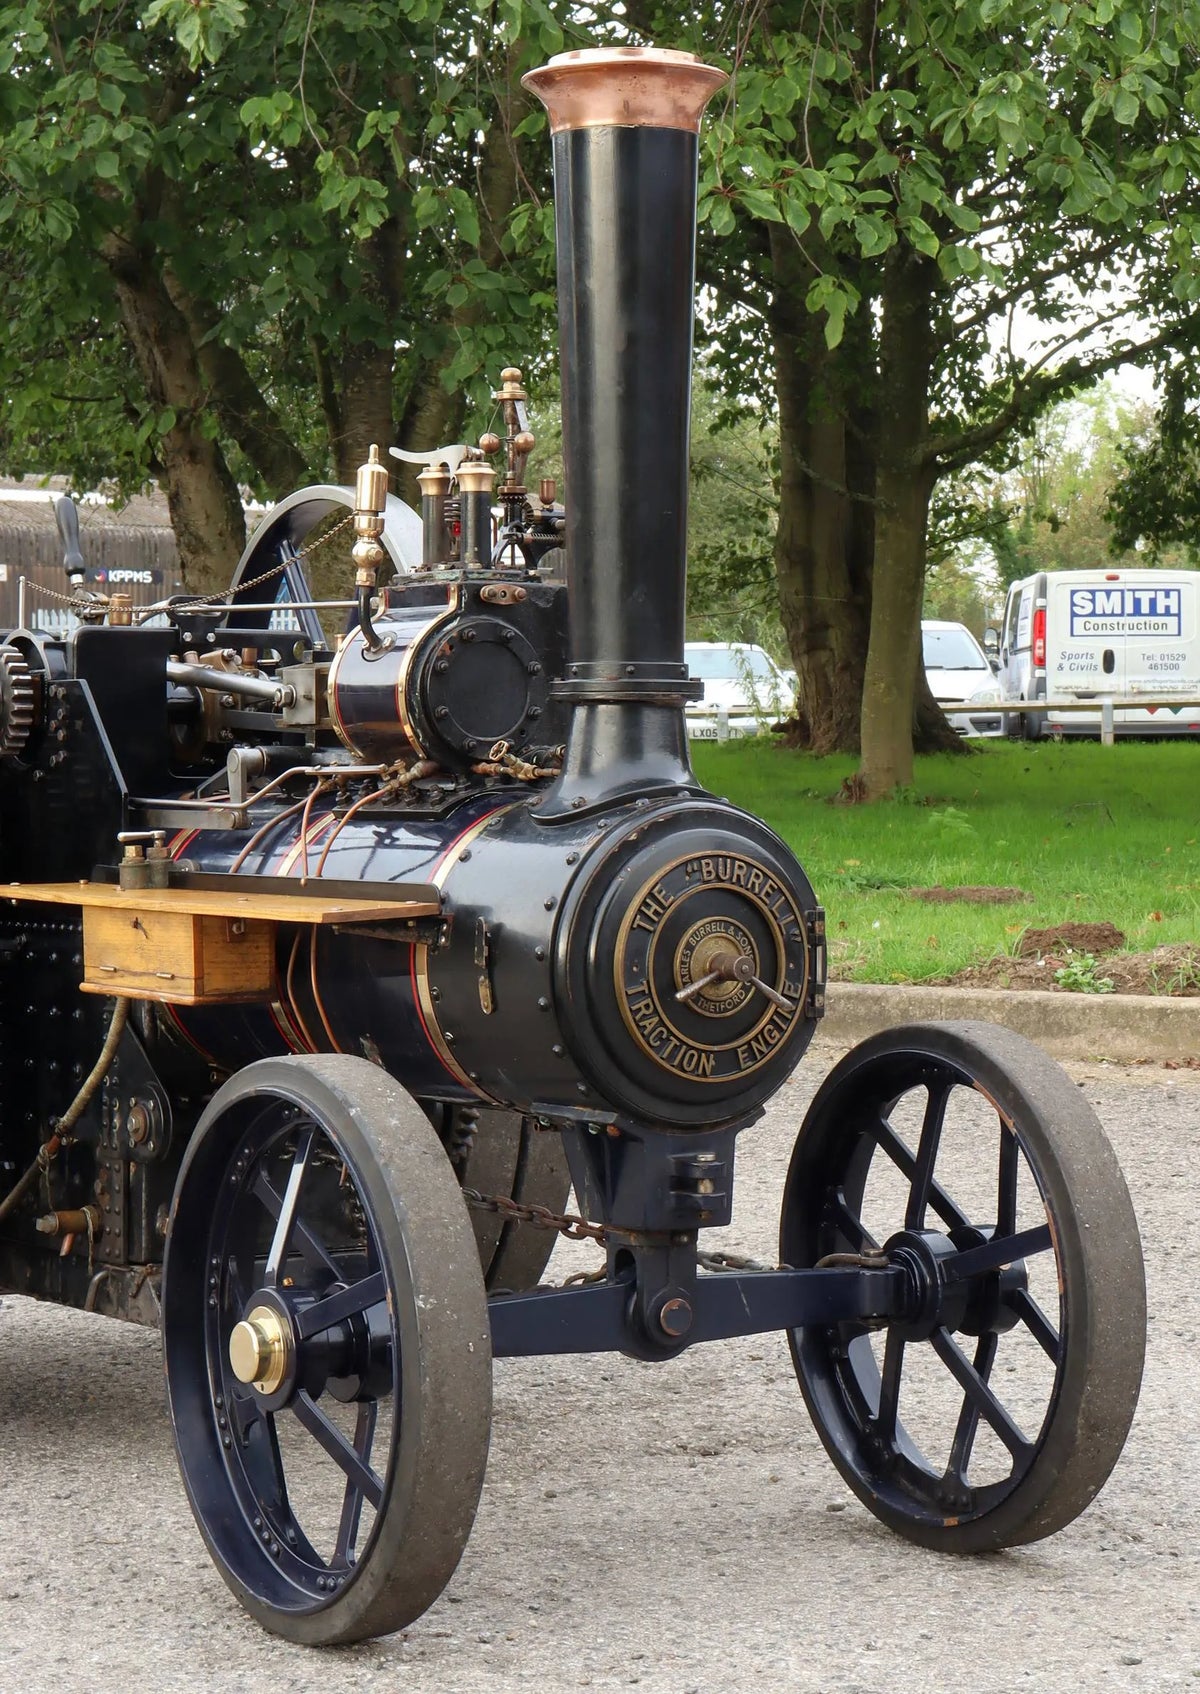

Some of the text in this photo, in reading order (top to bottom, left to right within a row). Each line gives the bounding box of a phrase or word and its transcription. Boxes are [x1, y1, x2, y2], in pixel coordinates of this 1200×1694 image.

[108, 570, 153, 584] KPPMS
[1072, 591, 1179, 615] SMITH
[1083, 620, 1168, 631] Construction
[1060, 651, 1095, 661] Sports
[1142, 653, 1187, 661] Tel: 01529
[1056, 662, 1099, 671] & Civils
[1148, 663, 1180, 671] 461500
[633, 883, 674, 931] THE
[689, 922, 726, 946] BURRELL
[727, 925, 735, 935] &
[698, 990, 746, 1013] THETFORD
[625, 980, 715, 1076] TRACTION
